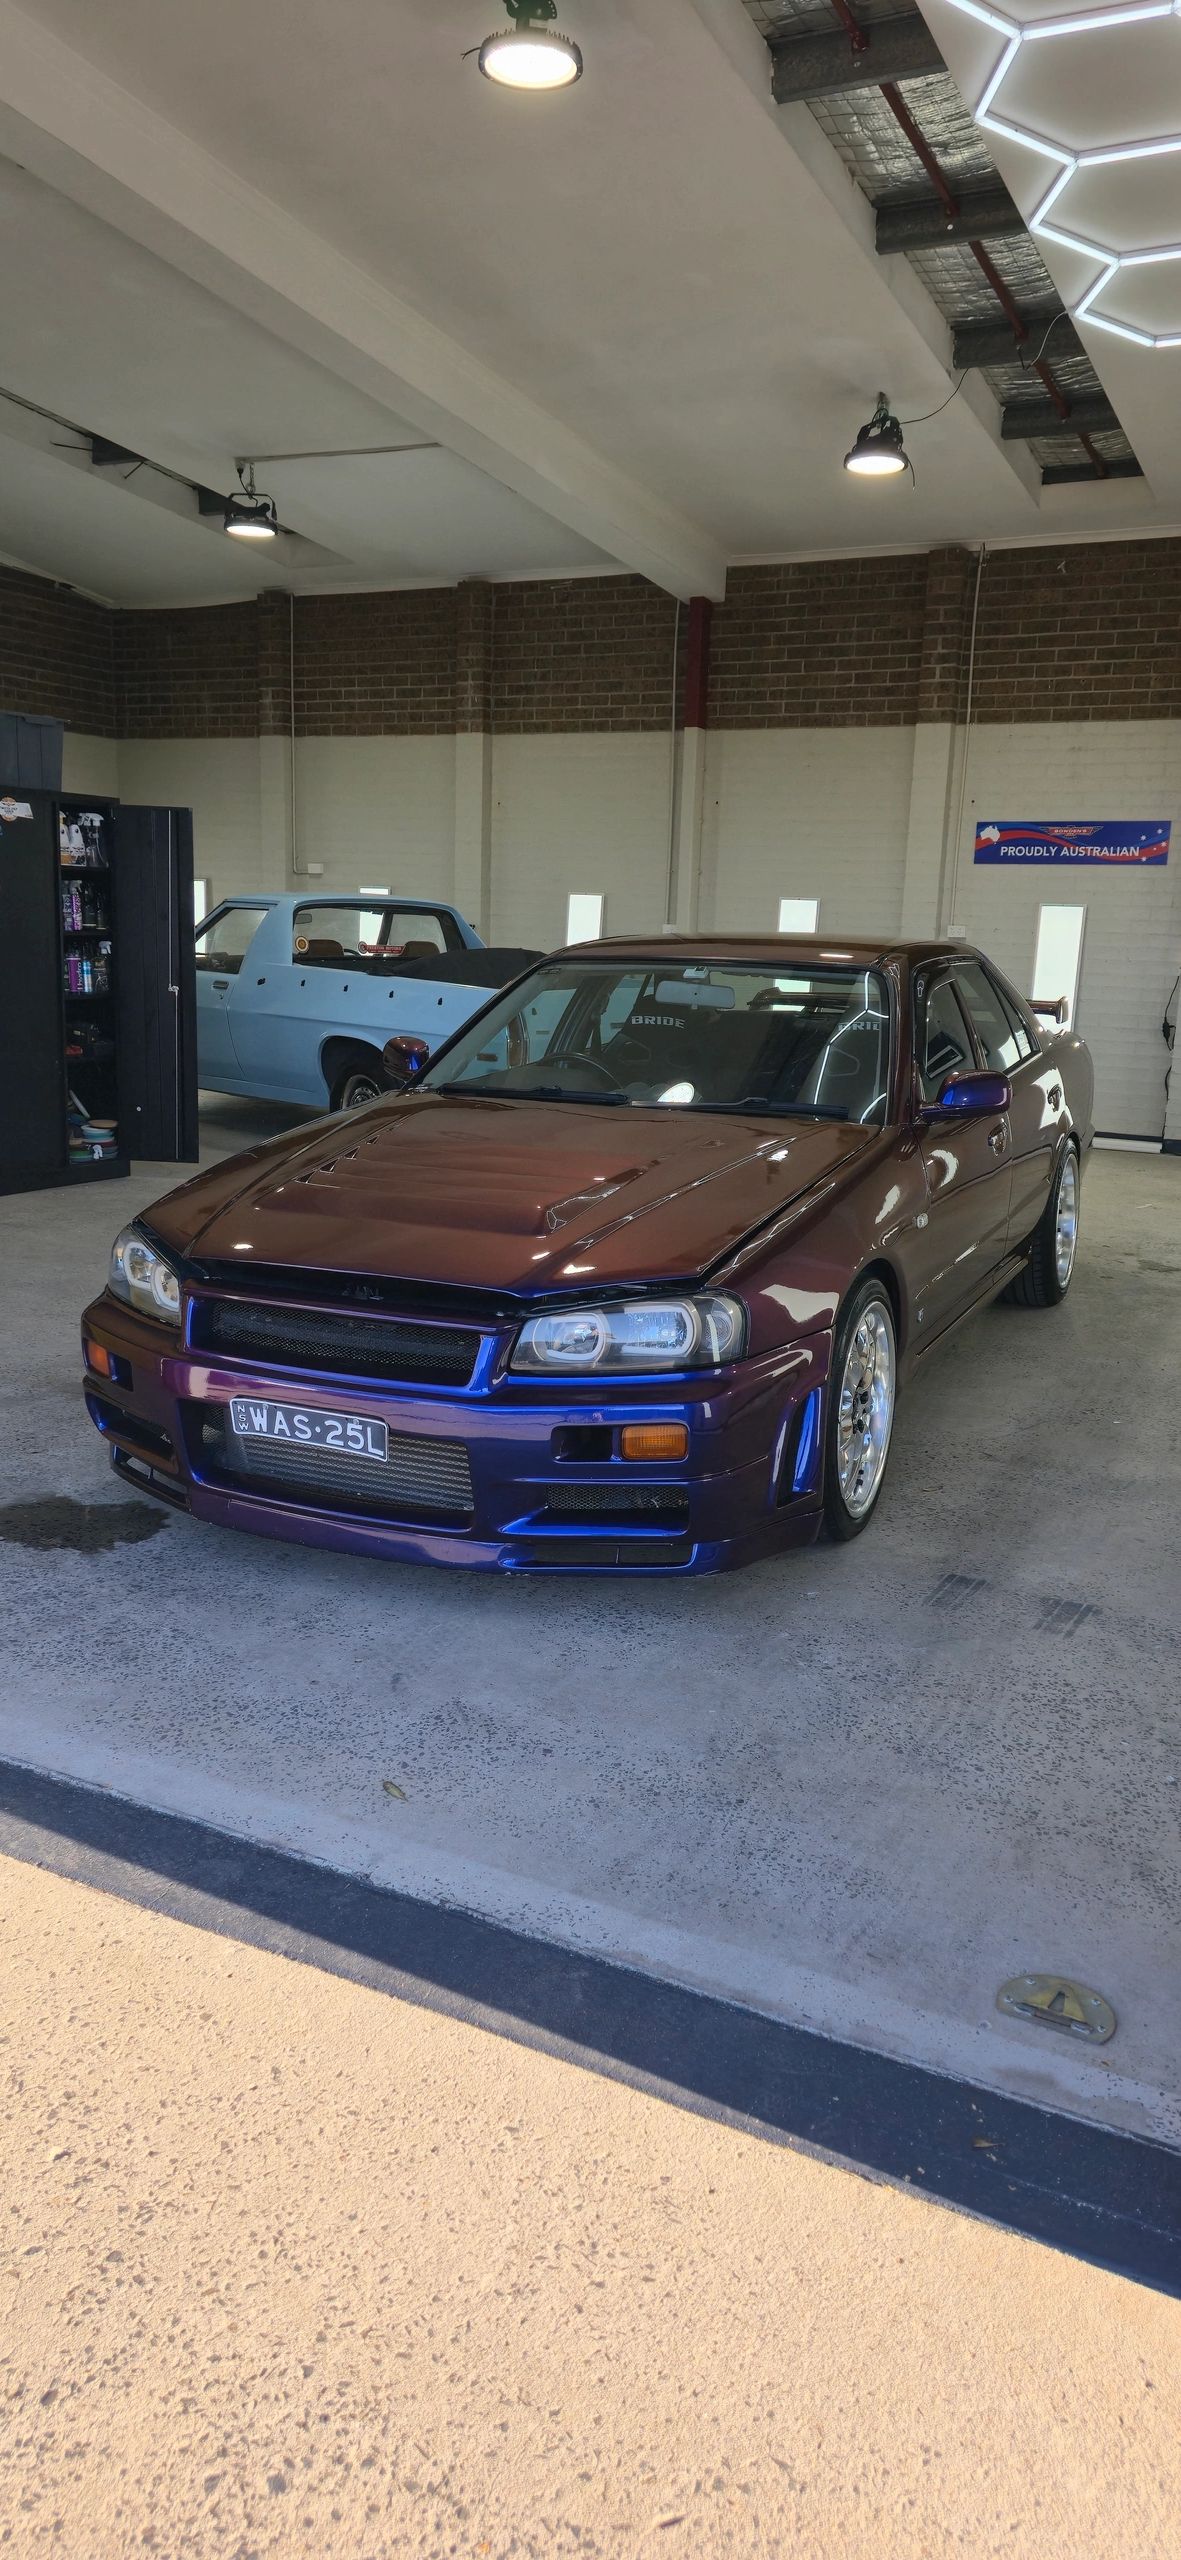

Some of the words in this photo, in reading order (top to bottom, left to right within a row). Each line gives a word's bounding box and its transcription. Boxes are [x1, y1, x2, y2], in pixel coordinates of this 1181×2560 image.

[1000, 846, 1057, 857] PROUDLY
[1060, 846, 1140, 857] AUSTRALIAN
[631, 1015, 686, 1029] BRIDE
